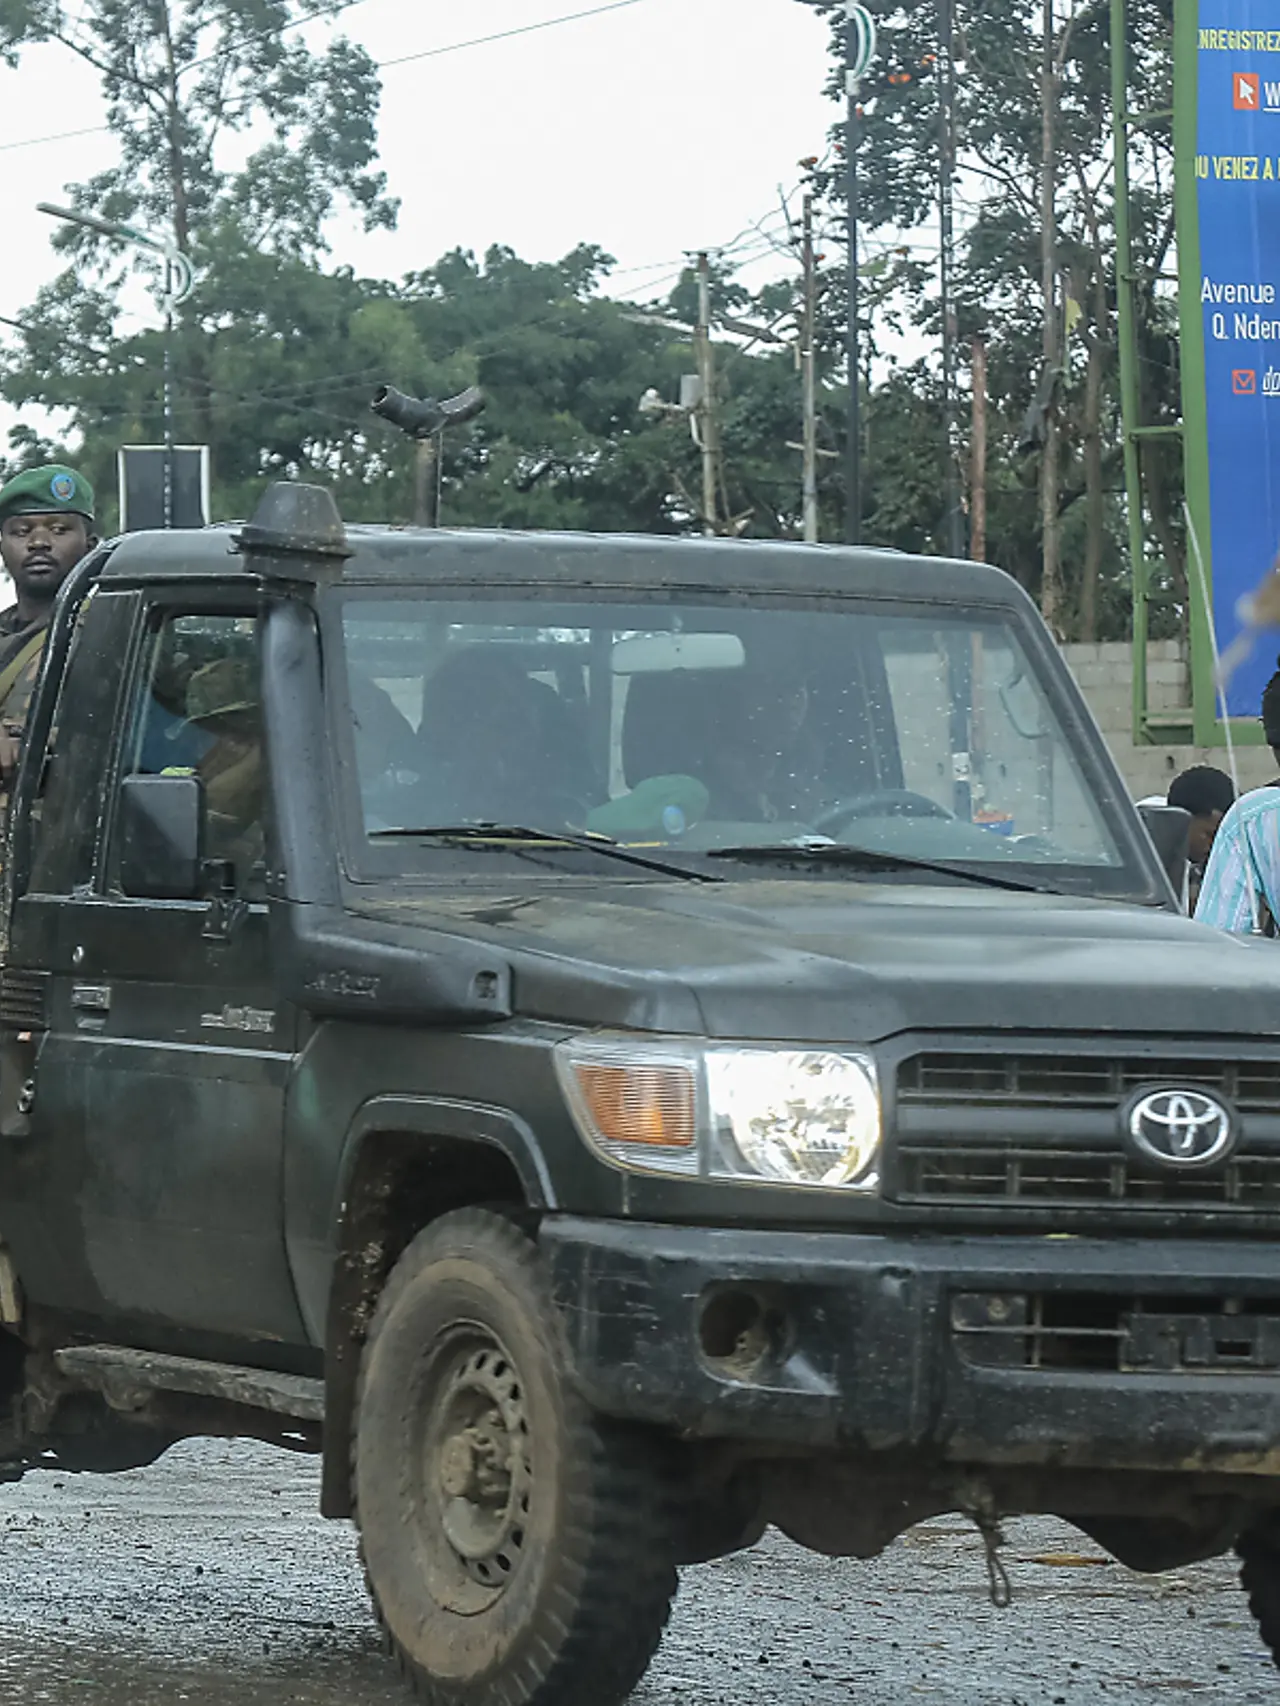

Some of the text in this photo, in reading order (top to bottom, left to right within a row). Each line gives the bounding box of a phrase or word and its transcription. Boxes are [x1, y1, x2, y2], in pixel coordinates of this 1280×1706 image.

[1198, 29, 1280, 51] NREGISTREZ
[1212, 156, 1259, 180] VENEZ
[1262, 157, 1275, 180] A
[1201, 276, 1275, 303] Avenue
